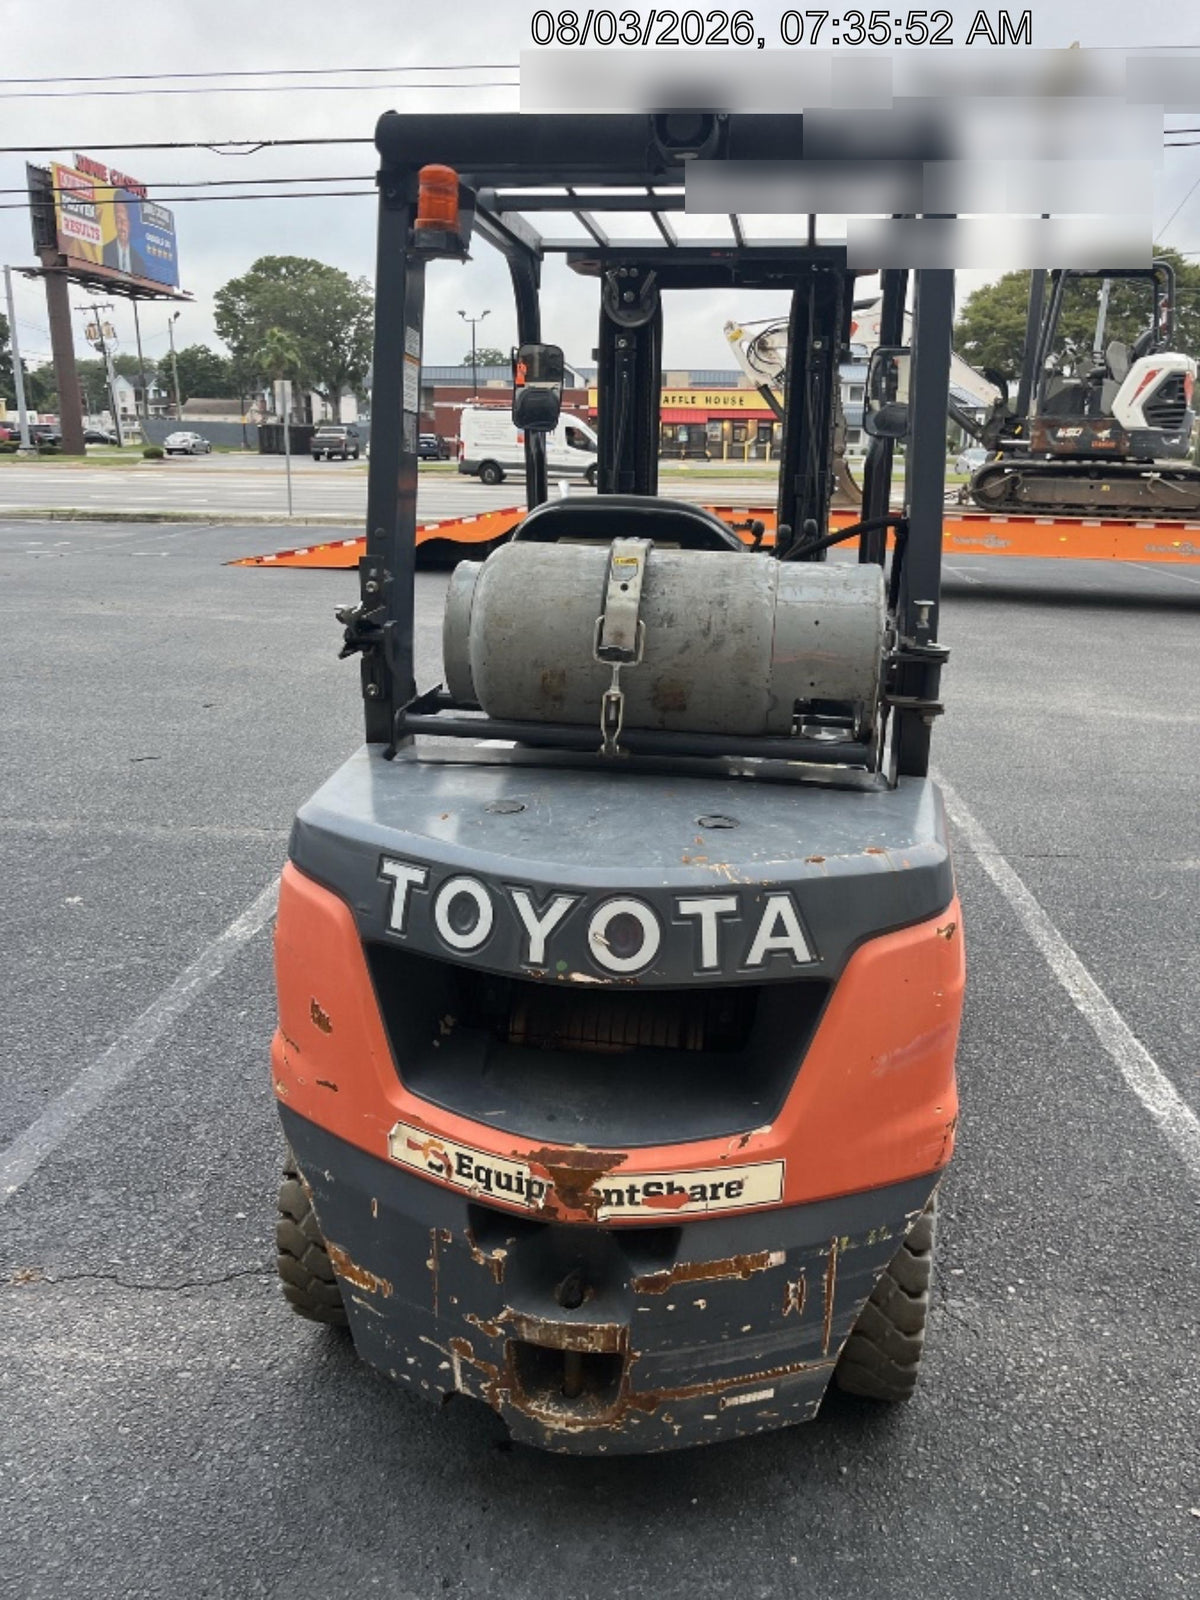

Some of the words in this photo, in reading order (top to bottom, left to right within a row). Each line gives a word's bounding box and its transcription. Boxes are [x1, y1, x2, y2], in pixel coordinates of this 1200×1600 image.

[63, 216, 101, 241] RESULTS
[663, 395, 696, 404] AFFLE
[705, 395, 744, 406] HOUSE
[380, 858, 813, 973] TOYOTA
[454, 1151, 745, 1207] EquipntShare
